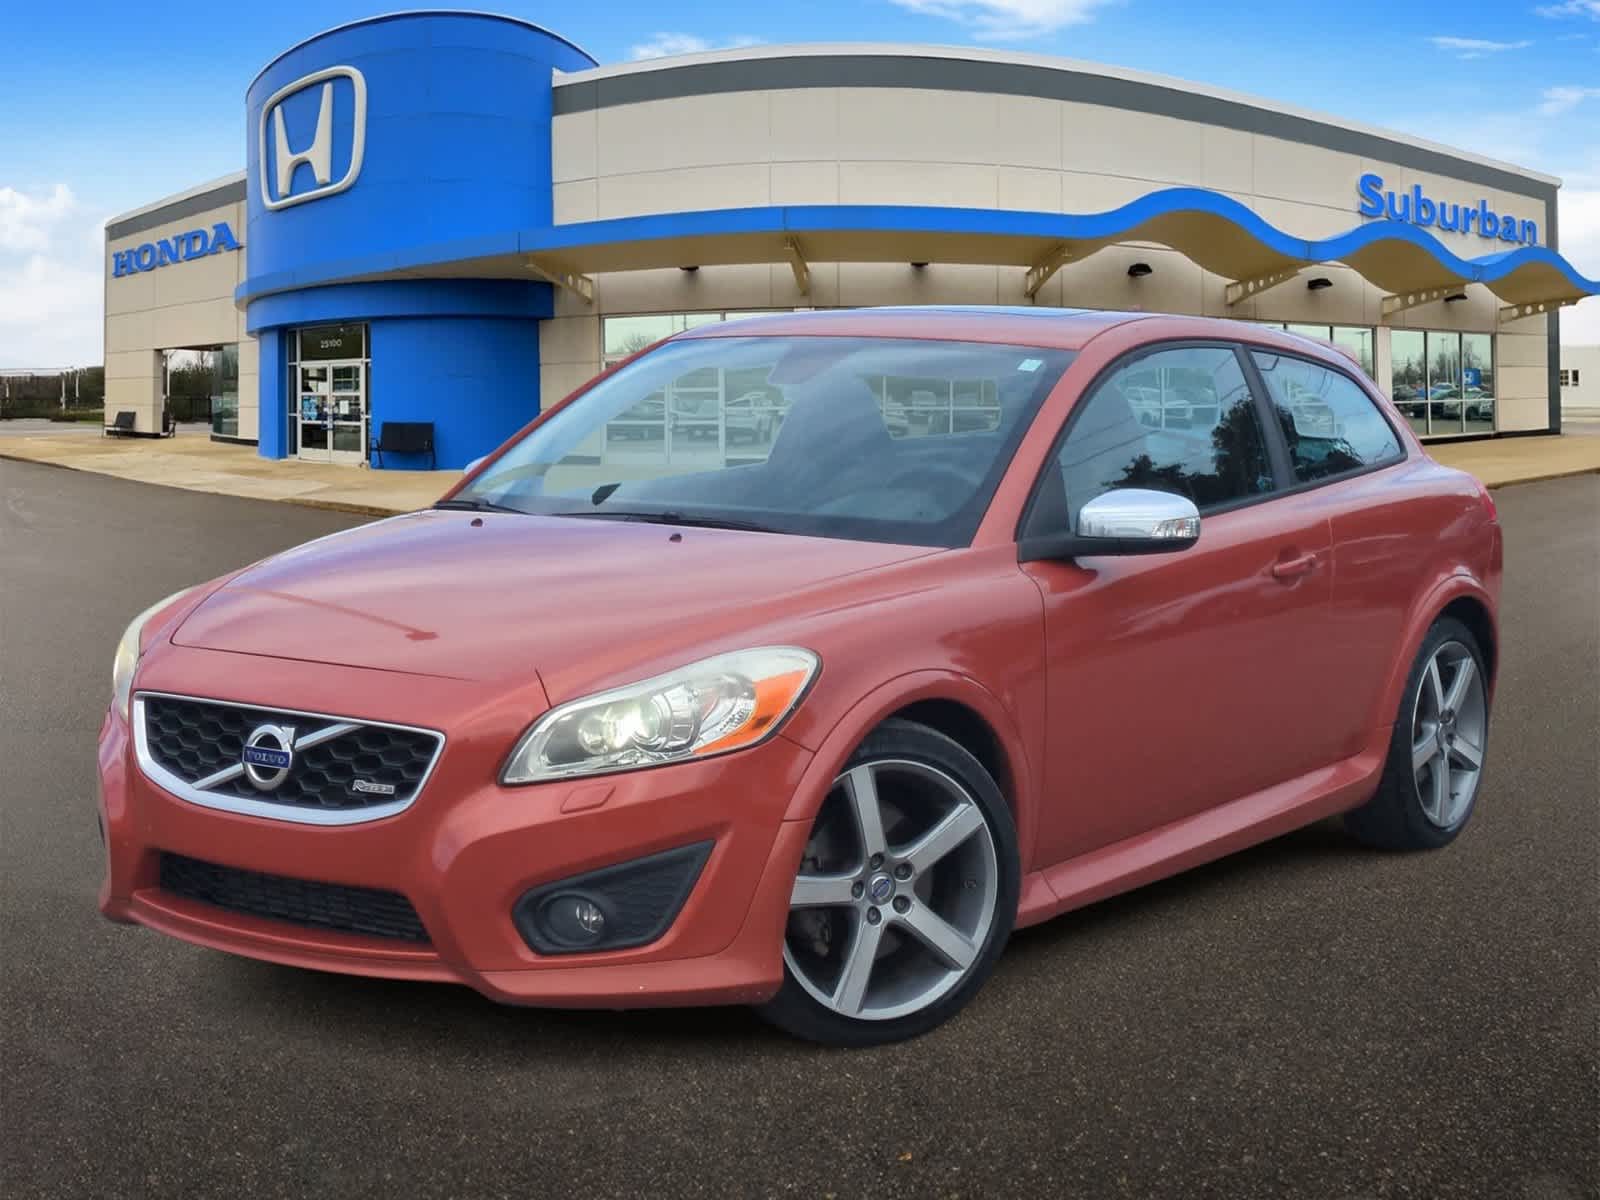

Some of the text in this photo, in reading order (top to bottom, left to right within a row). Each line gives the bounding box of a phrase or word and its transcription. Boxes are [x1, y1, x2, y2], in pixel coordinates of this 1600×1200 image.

[1360, 174, 1537, 246] Suburban
[112, 222, 241, 277] HONDA
[246, 750, 287, 765] VOLVO
